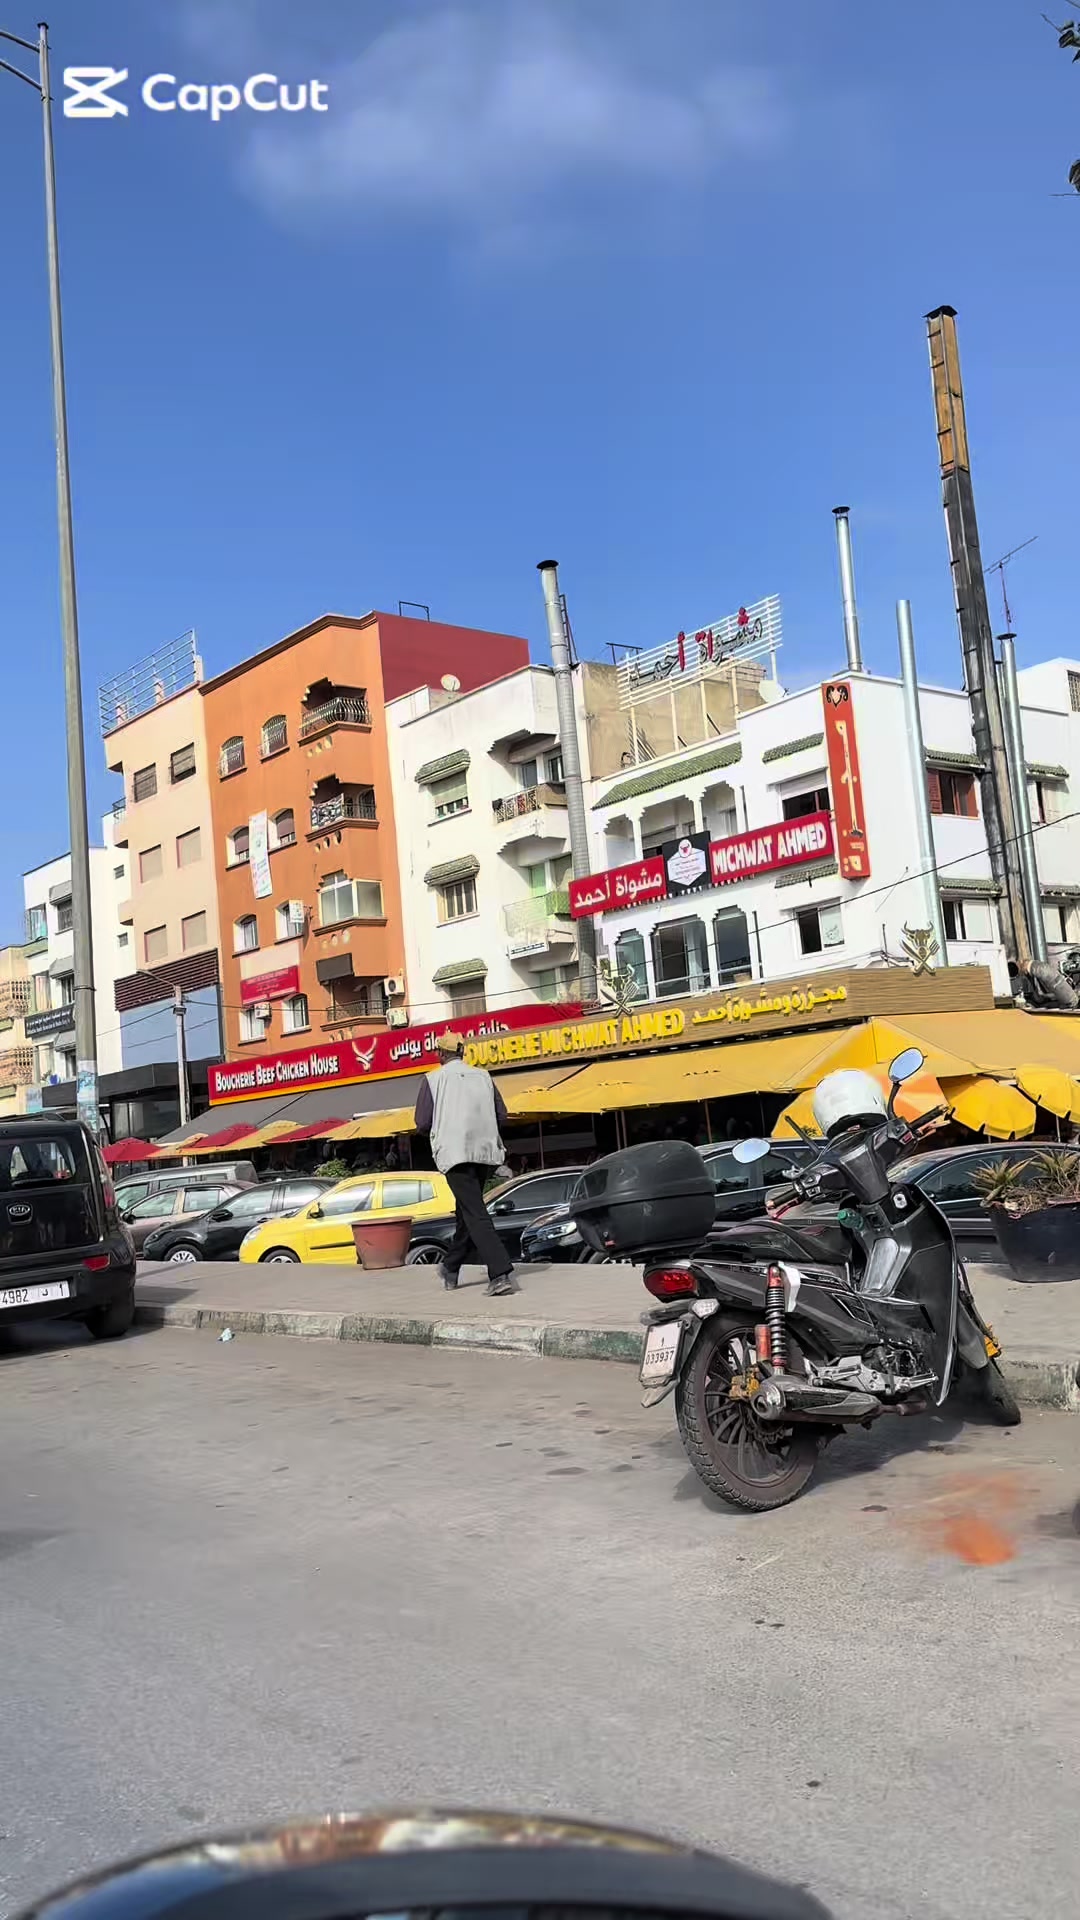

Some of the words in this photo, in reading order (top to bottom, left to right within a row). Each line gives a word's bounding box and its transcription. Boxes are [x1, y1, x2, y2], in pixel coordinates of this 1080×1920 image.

[696, 606, 763, 667] مشواة
[628, 630, 687, 691] أحمد
[711, 834, 773, 876] MICHWAT
[777, 821, 827, 860] AHMED
[574, 873, 611, 908] أحمد
[615, 867, 663, 900] مشواة
[691, 992, 733, 1024] أحمد
[791, 983, 848, 1012] مجزرة
[540, 1018, 620, 1056] MICHWAT
[621, 1007, 685, 1044] AHMED
[389, 1037, 423, 1061] يونس
[214, 1070, 256, 1093] BOUCHERIE
[255, 1063, 276, 1086] BEEF
[275, 1060, 310, 1081] CHICKEN
[310, 1053, 340, 1077] HOUSE
[2, 1289, 29, 1304] 4982
[645, 1350, 675, 1365] 033937
